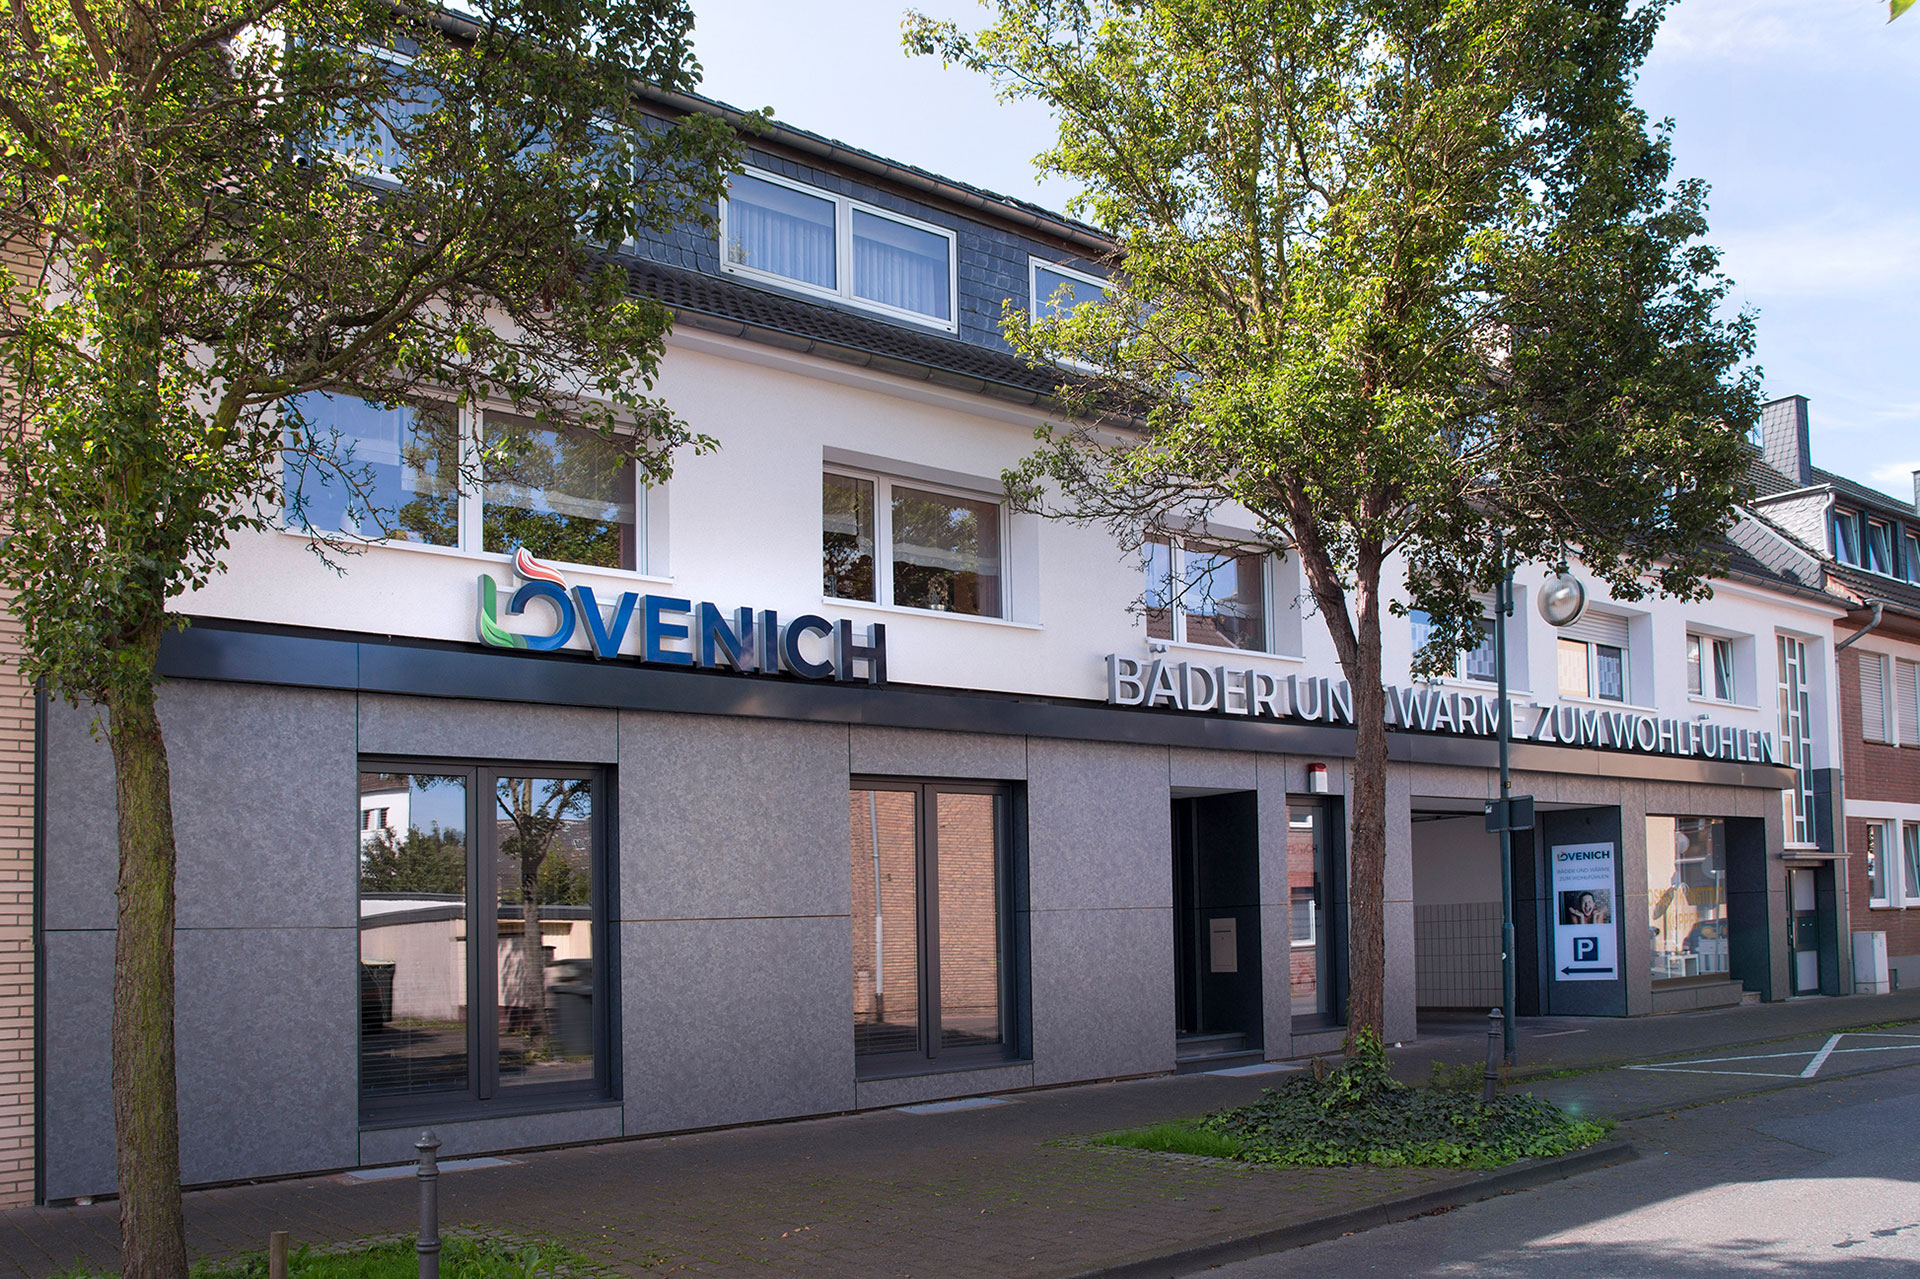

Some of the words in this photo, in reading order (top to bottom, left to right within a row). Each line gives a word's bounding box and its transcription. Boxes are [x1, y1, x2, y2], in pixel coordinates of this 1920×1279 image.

[1107, 644, 1280, 718] BÄDER
[1287, 673, 1355, 726] UN
[1531, 702, 1603, 748] ZUM
[1602, 711, 1773, 763] WOHLFÜHLEN
[1577, 939, 1594, 960] P
